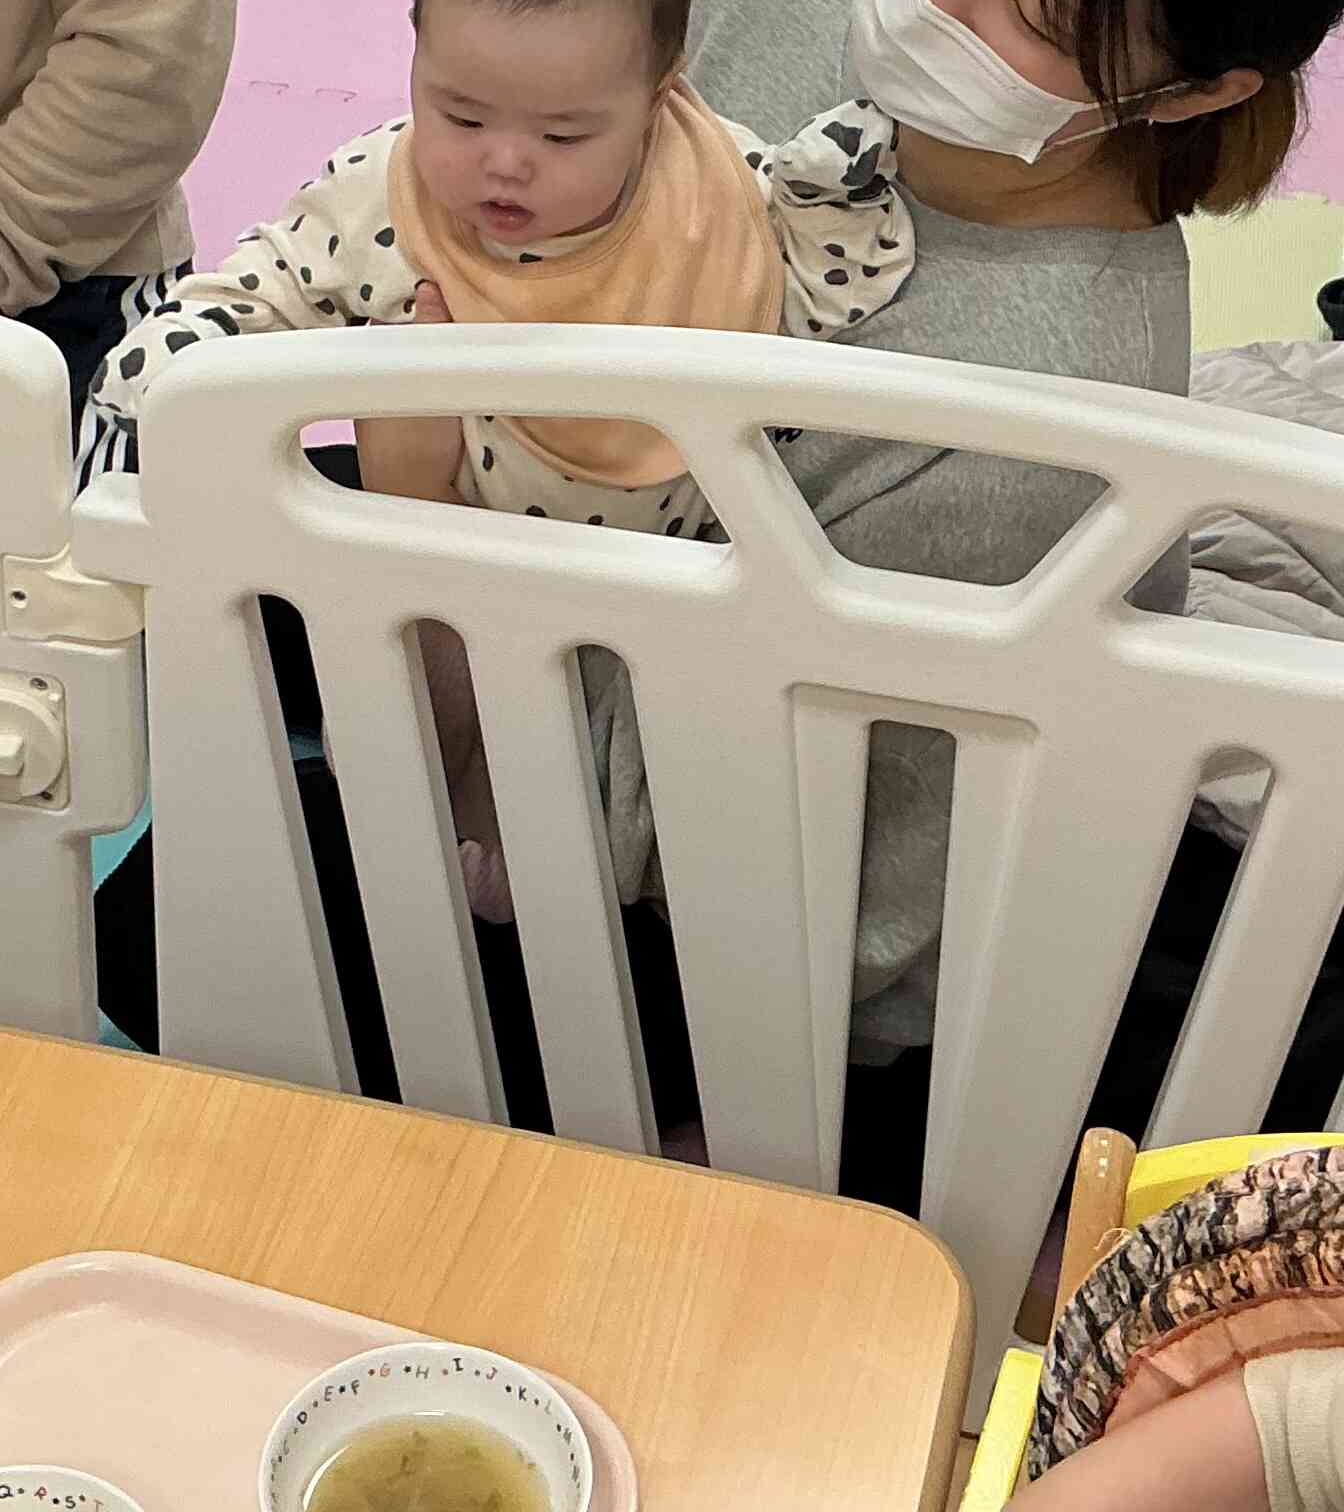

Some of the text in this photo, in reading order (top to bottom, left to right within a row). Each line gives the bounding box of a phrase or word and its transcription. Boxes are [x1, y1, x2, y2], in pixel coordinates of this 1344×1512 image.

[324, 1385, 334, 1402] E
[351, 1379, 360, 1395] F
[379, 1363, 391, 1377] G
[416, 1365, 430, 1380] H
[453, 1357, 464, 1372] I
[486, 1367, 498, 1380] J
[518, 1385, 527, 1401] K
[34, 1486, 47, 1500] R
[65, 1495, 76, 1509] S
